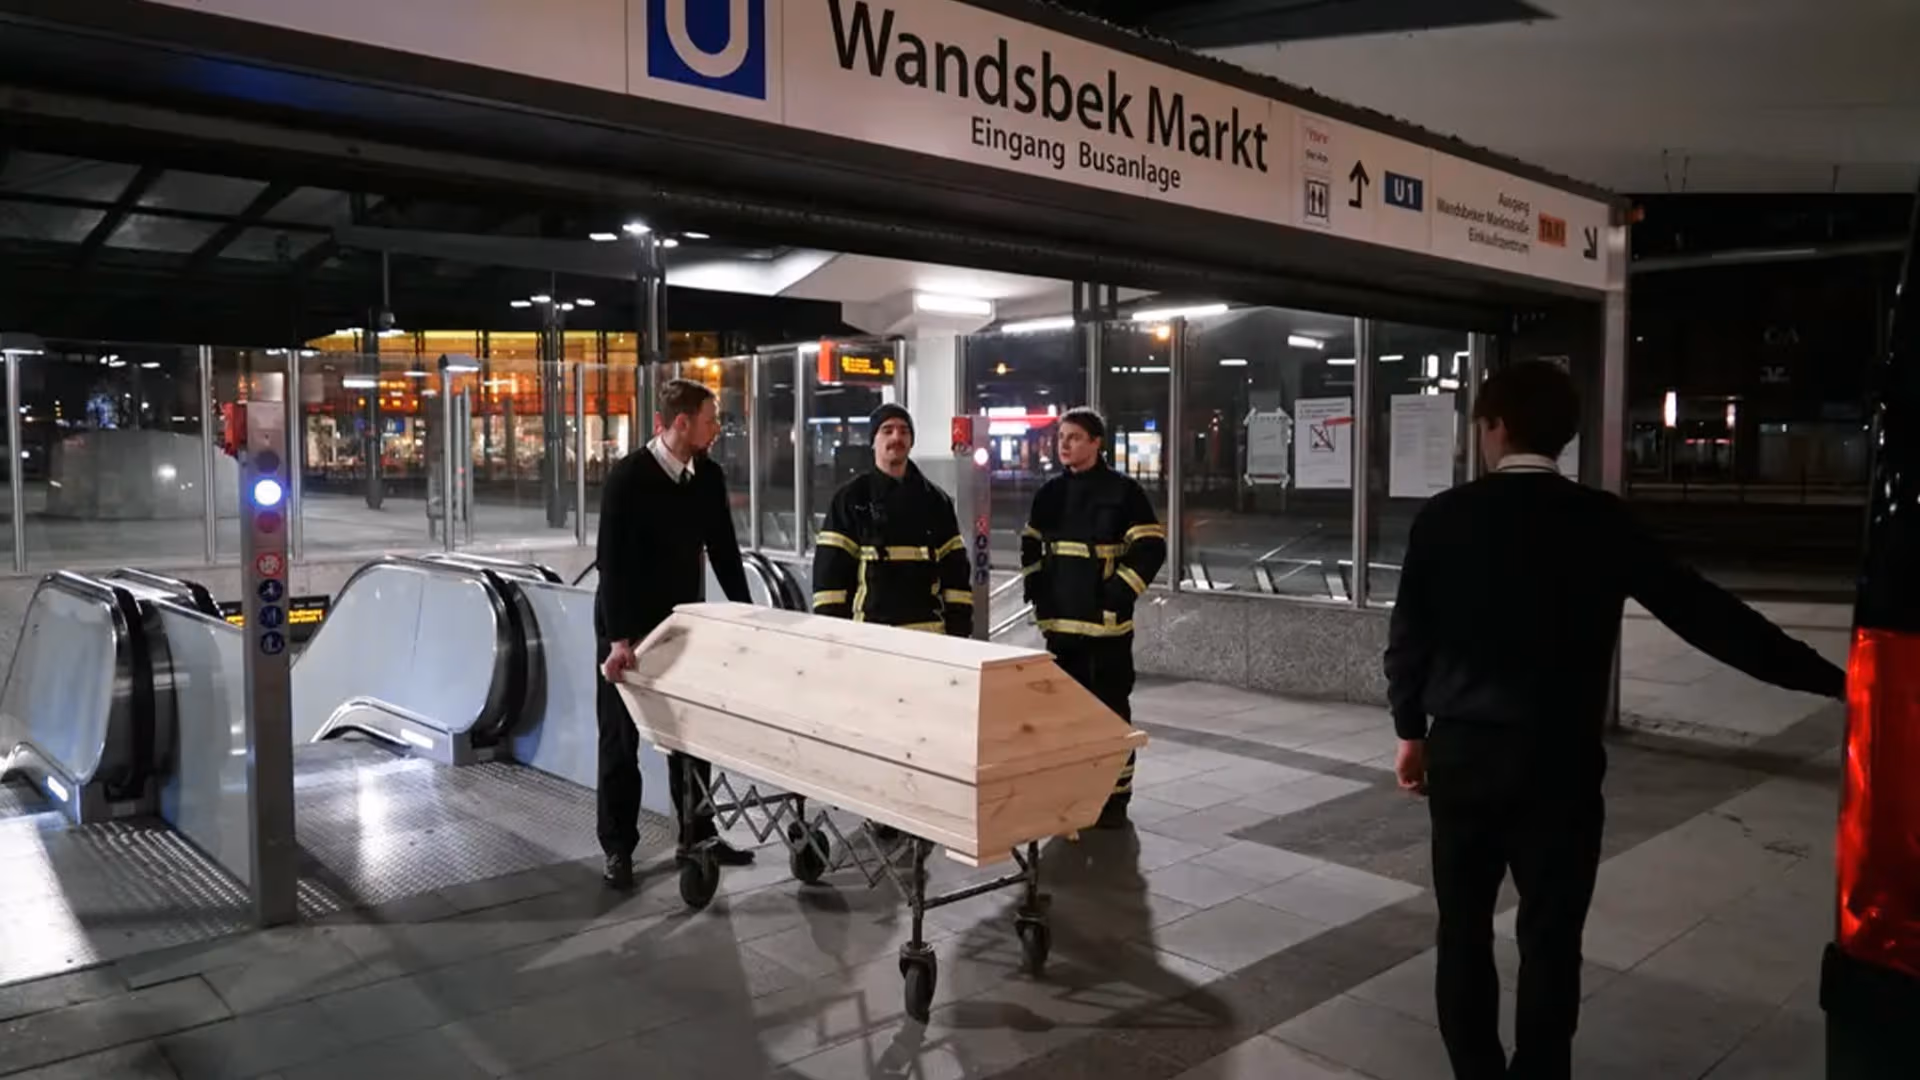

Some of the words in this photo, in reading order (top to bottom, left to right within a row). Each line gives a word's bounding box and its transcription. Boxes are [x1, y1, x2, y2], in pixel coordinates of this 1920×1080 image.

[665, 0, 749, 78] U
[828, 0, 1133, 139] Wandsbek
[1147, 85, 1268, 173] Markt
[971, 116, 1065, 169] Eingang
[1079, 147, 1181, 191] Busanlage
[1394, 178, 1414, 204] U1
[1498, 192, 1530, 217] Ausgang
[1540, 217, 1566, 245] TAXI
